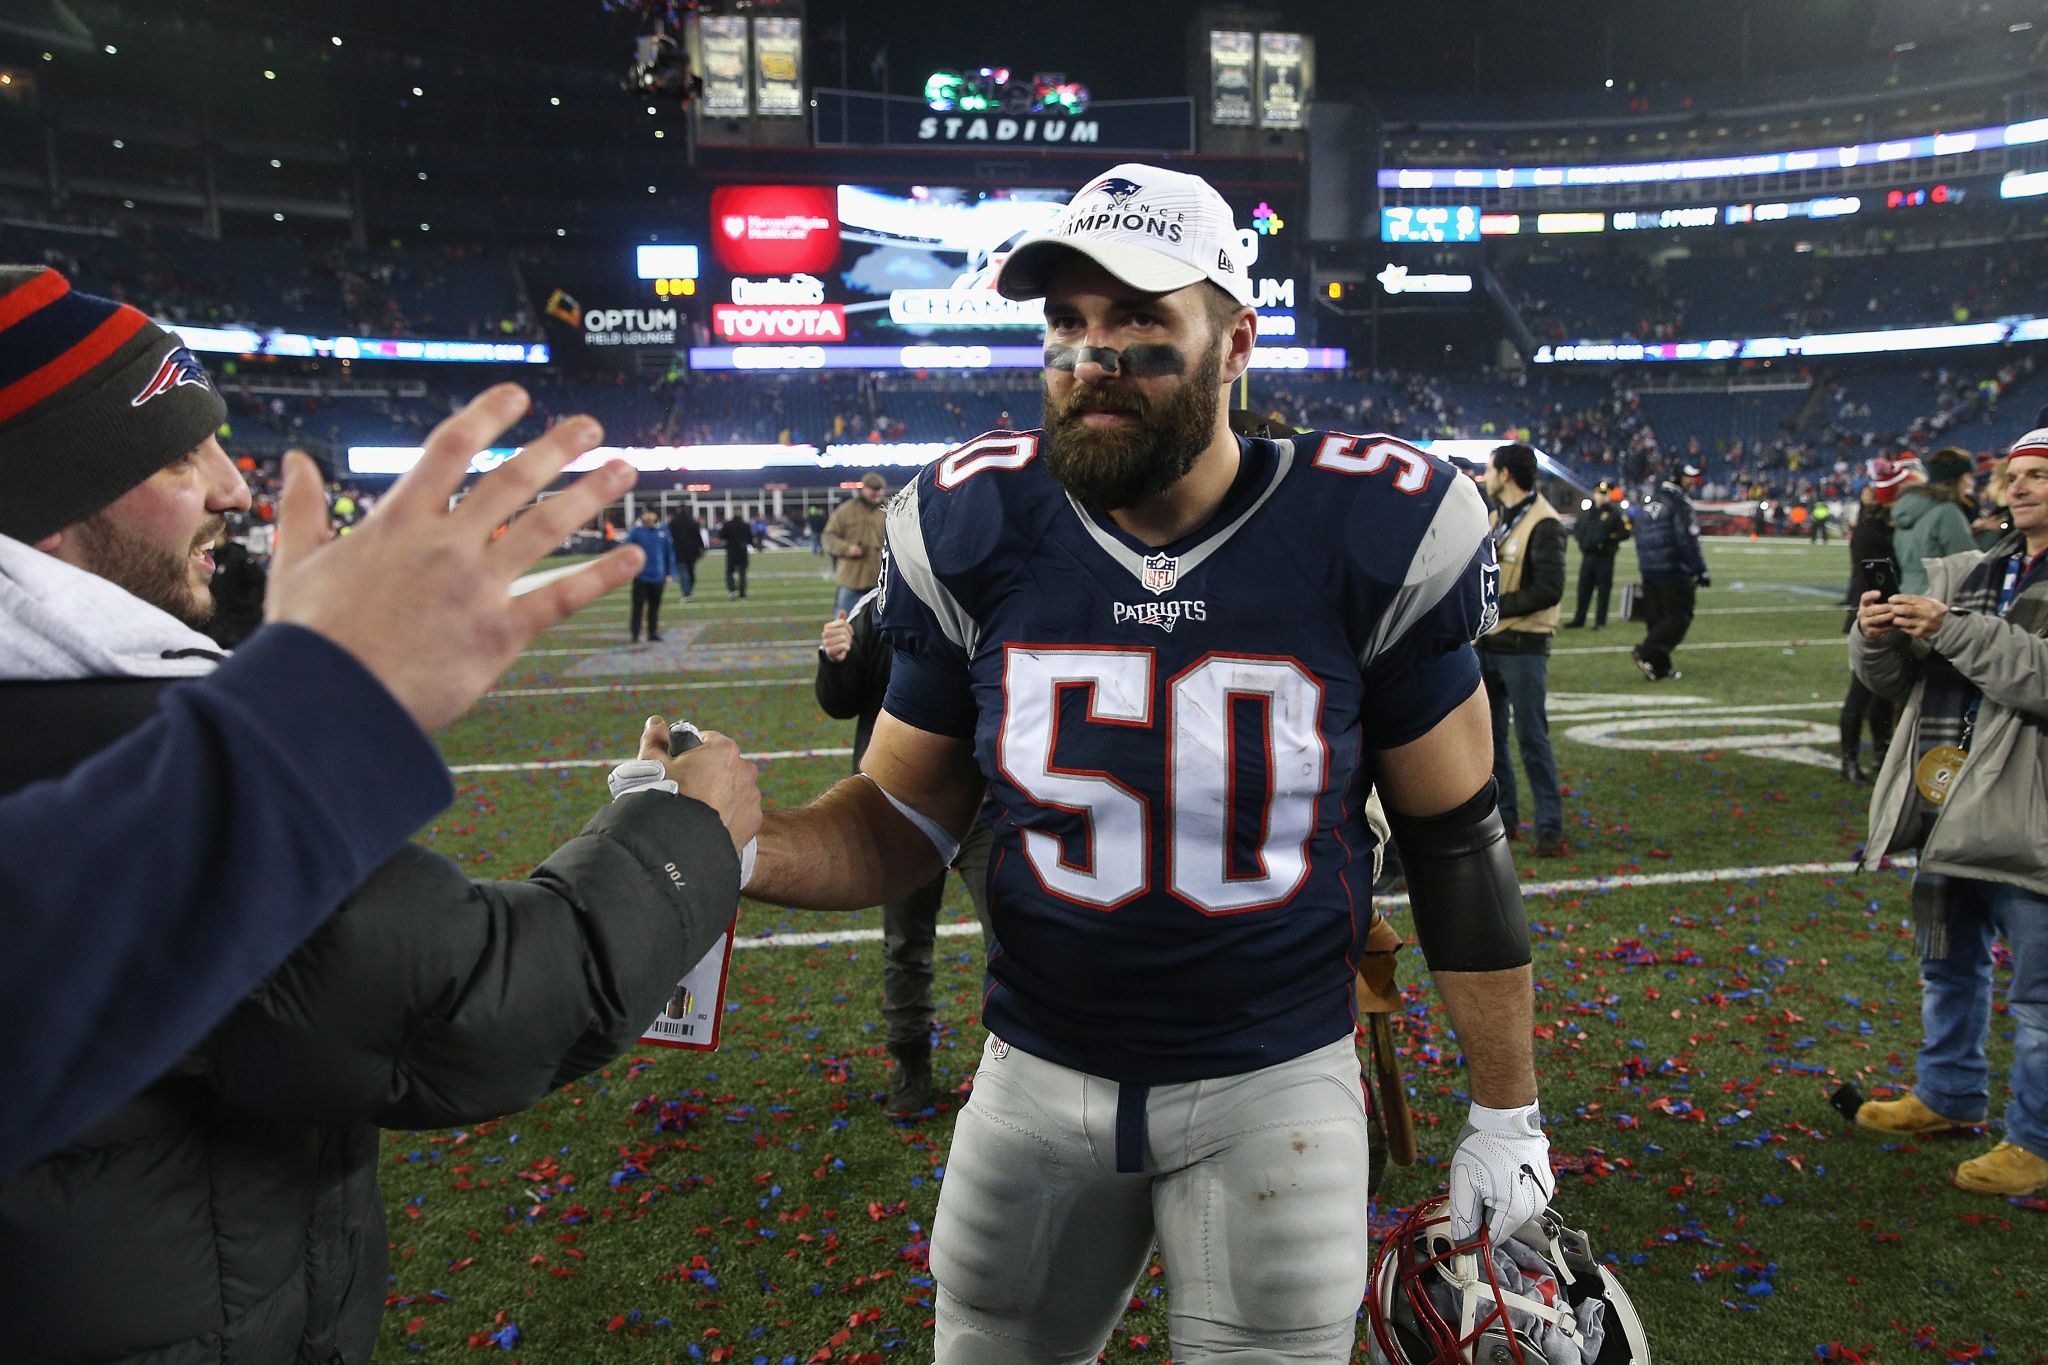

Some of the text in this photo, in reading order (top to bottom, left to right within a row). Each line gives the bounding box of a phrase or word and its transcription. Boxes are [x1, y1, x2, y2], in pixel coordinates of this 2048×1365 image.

[918, 116, 1100, 143] STADIUM
[1062, 213, 1184, 243] AMPIONS
[584, 308, 677, 332] OPTUM
[717, 309, 842, 336] TOYOTA
[585, 331, 621, 345] FIELD
[1147, 570, 1173, 588] NFL
[1113, 600, 1207, 625] PATRIOTS
[998, 642, 1327, 915] 50
[664, 862, 687, 890] 700
